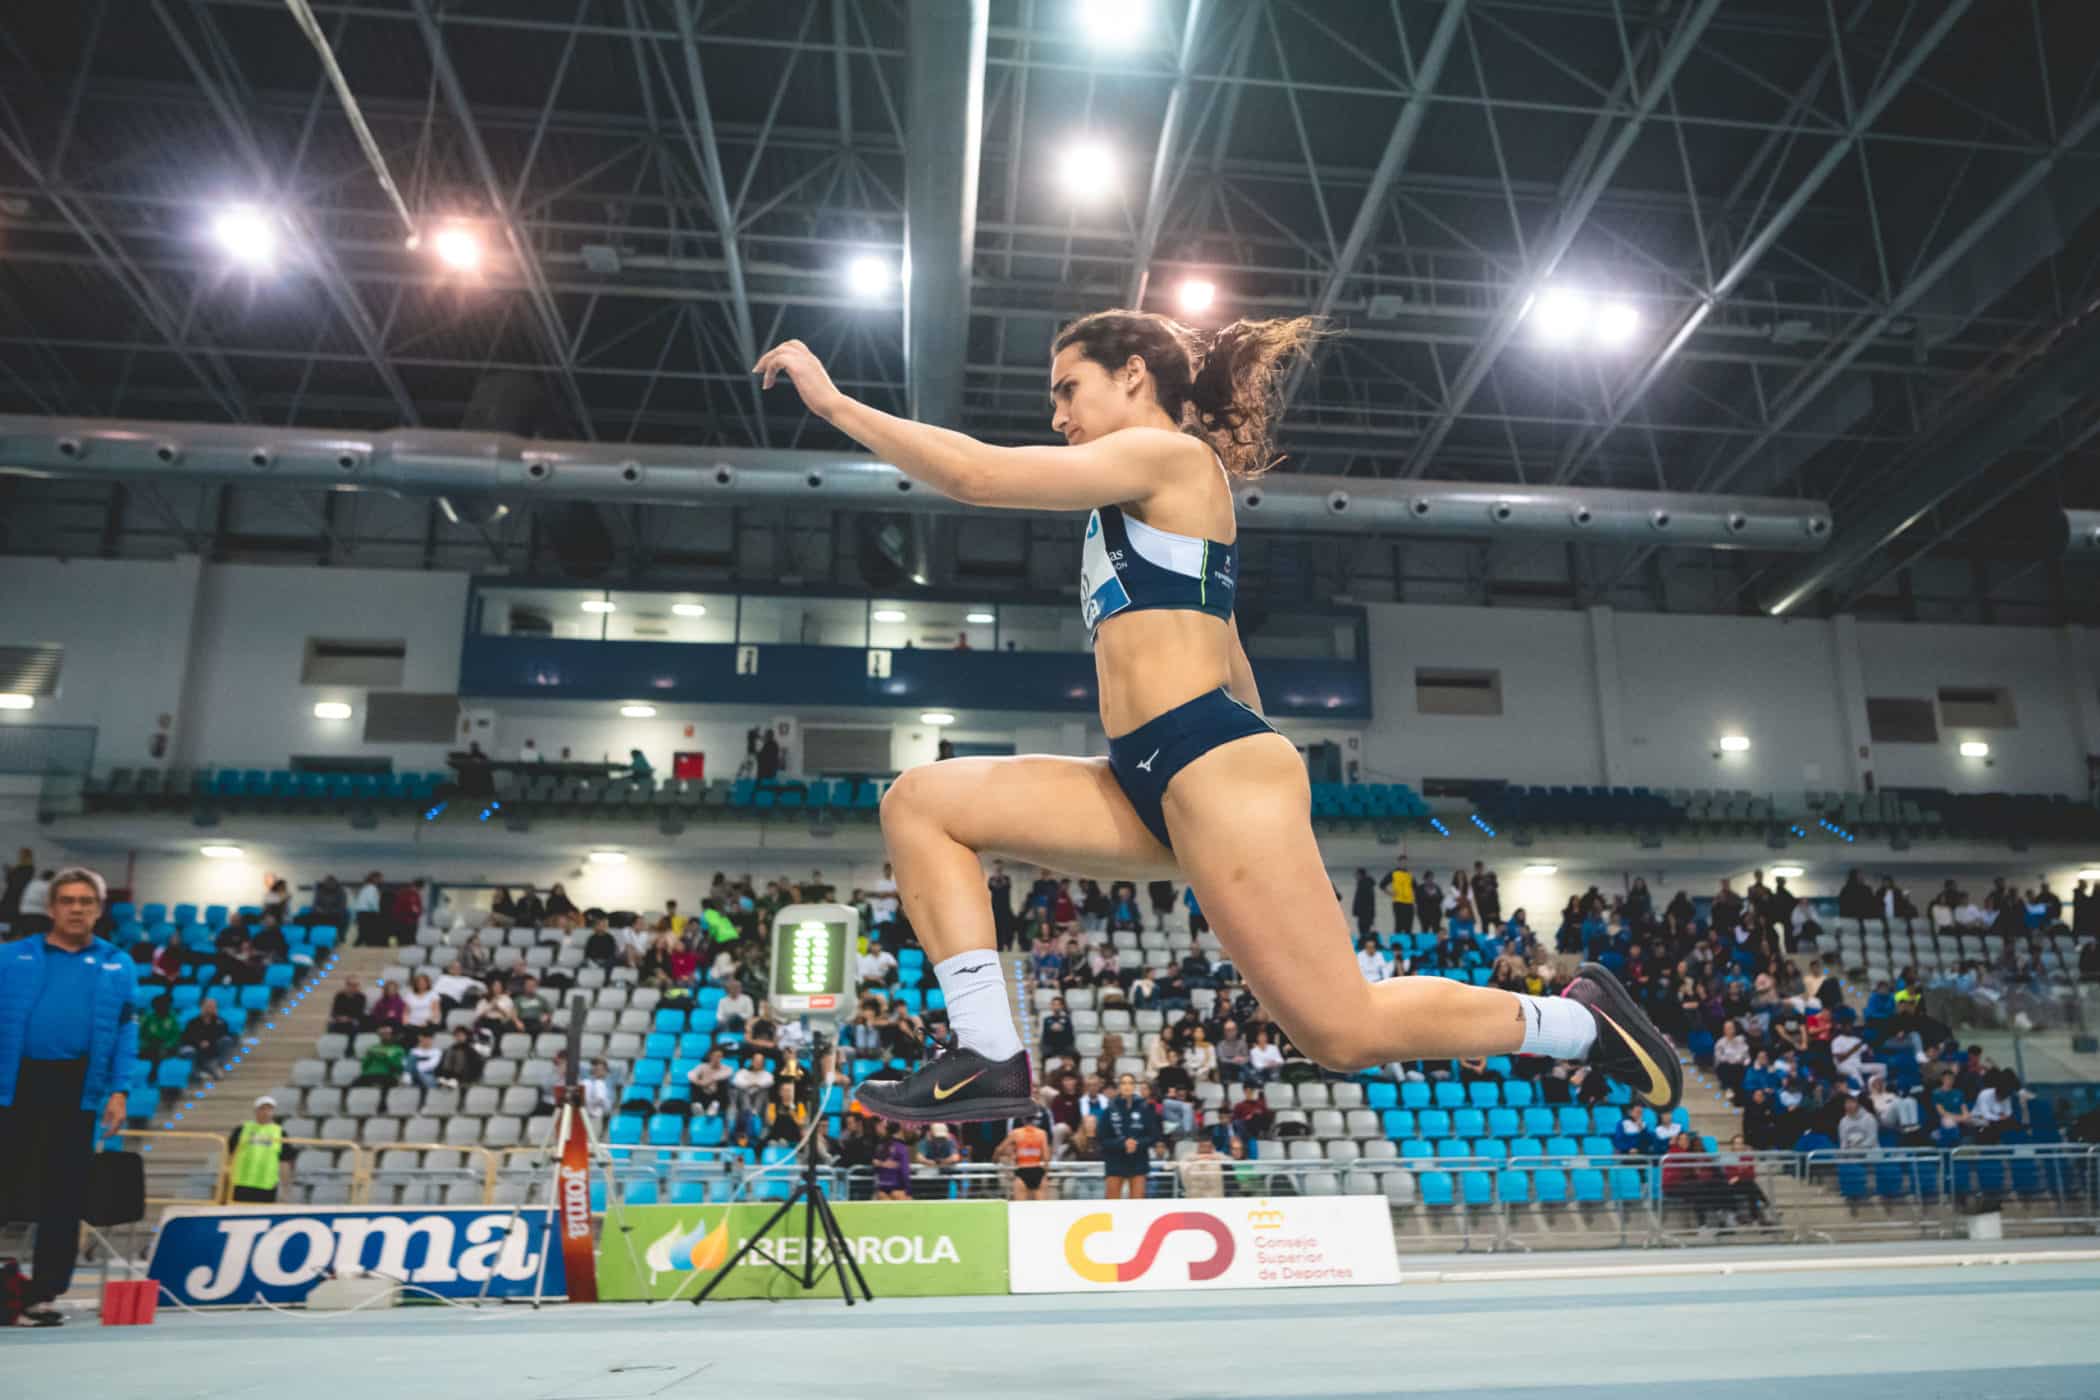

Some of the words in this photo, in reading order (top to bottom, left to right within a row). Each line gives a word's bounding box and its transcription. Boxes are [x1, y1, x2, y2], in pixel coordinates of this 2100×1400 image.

[1254, 1235, 1318, 1253] Consejo
[1257, 1250, 1323, 1265] Superior
[1258, 1267, 1277, 1280] de
[1283, 1265, 1353, 1281] Deportes
